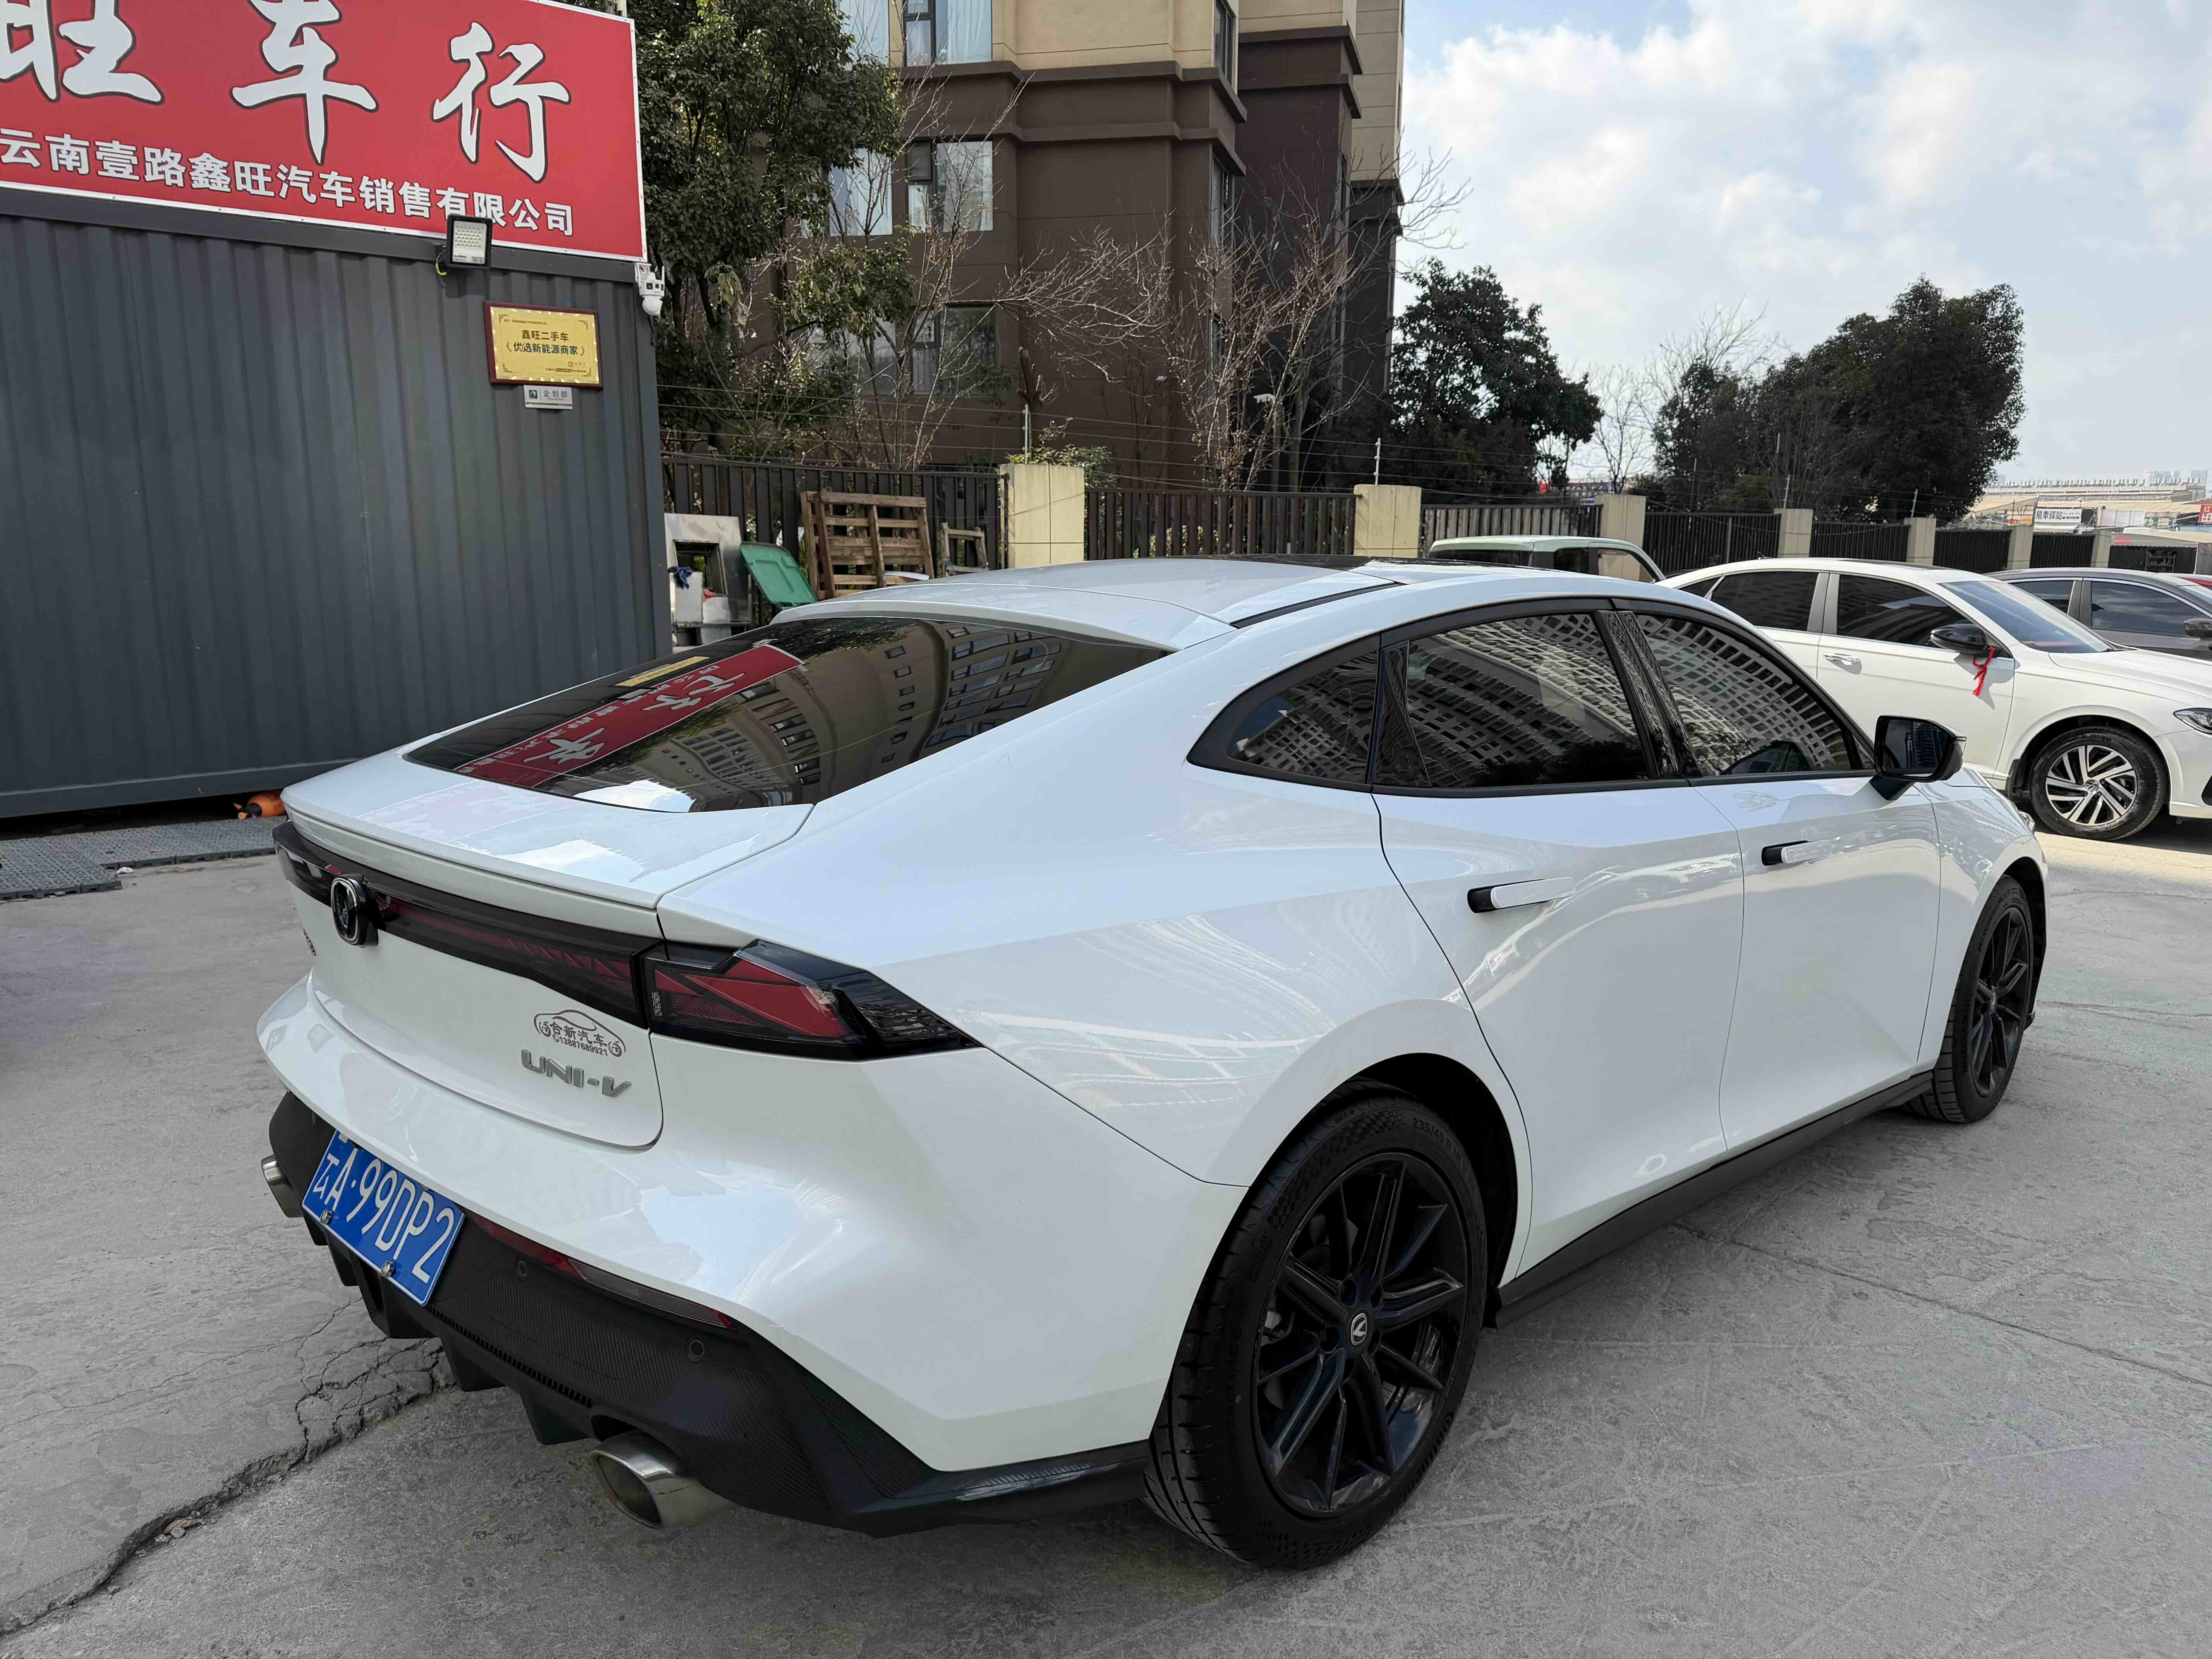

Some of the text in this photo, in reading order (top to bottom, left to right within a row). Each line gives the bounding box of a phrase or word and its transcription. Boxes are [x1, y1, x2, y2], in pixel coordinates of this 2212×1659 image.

[0, 128, 574, 237] 云南壹路鑫旺汽车销售有限公司
[522, 330, 569, 342] 鑫旺二手车
[513, 342, 578, 355] 优选新能源商家
[543, 390, 568, 398] 企划部
[549, 1021, 608, 1047] 合新汽车
[559, 1036, 608, 1056] 13887689921
[521, 1049, 632, 1097] UNI-V
